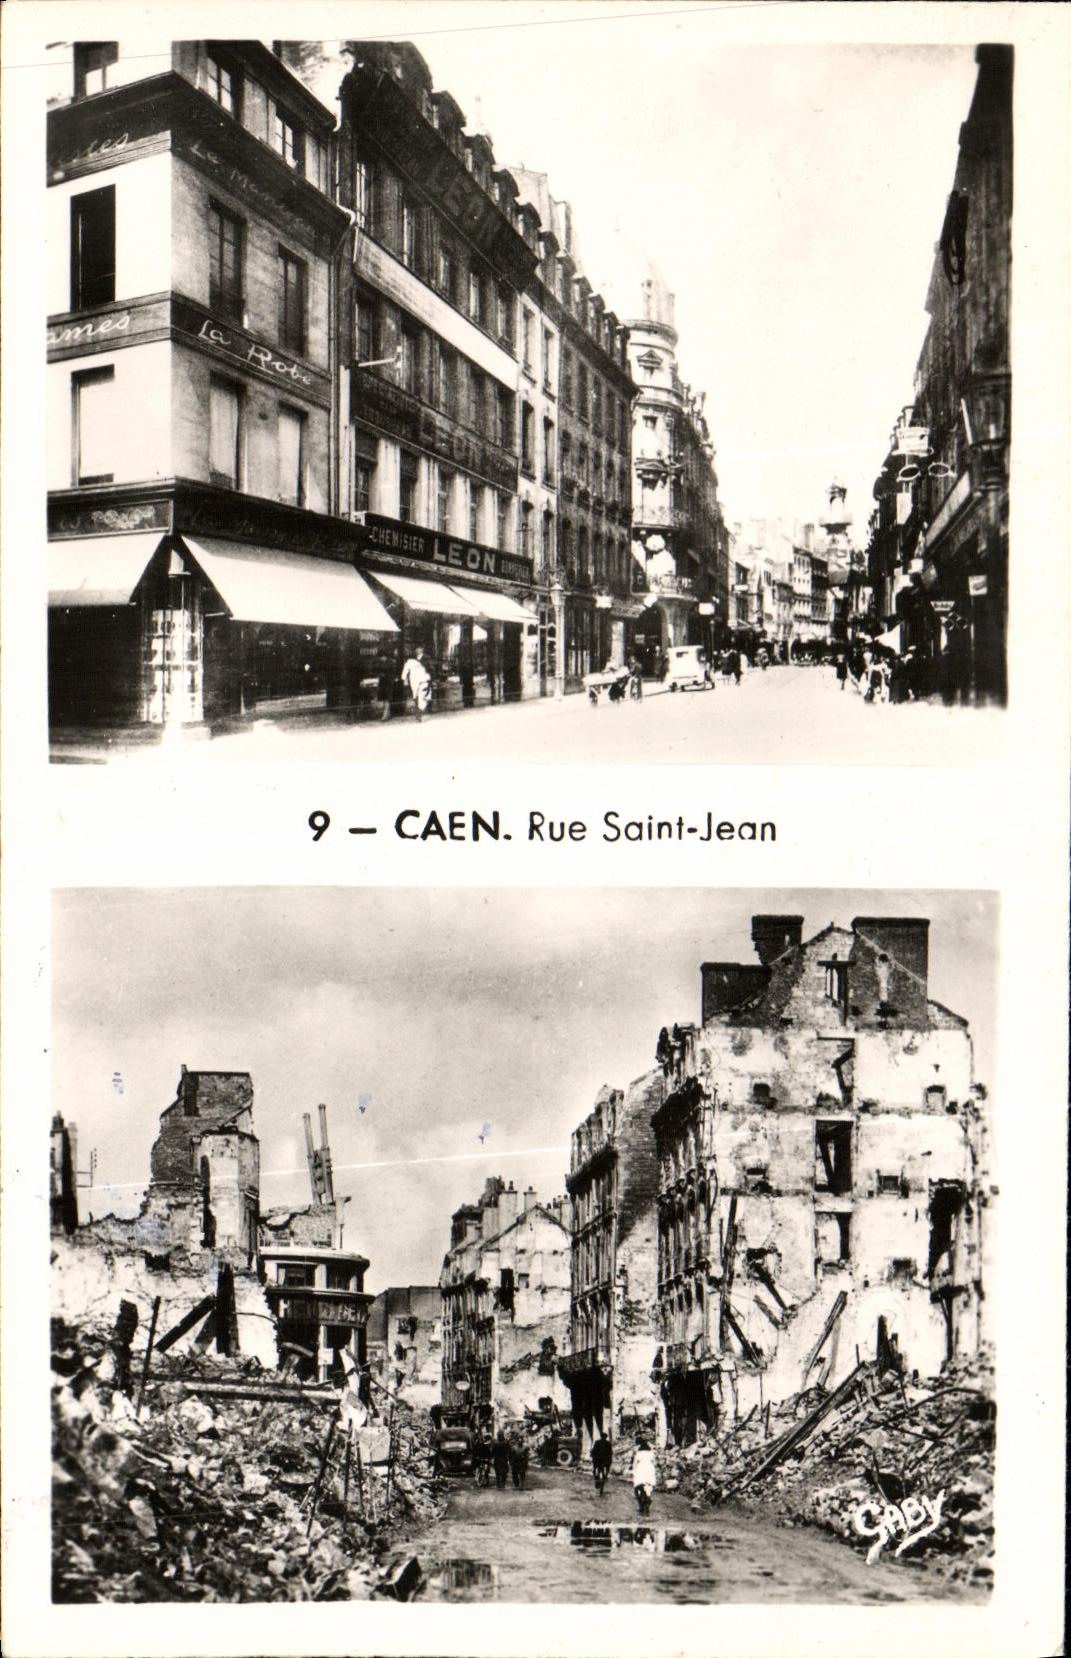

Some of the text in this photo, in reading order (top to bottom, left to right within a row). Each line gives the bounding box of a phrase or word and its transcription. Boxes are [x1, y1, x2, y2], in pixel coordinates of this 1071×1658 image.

[198, 319, 312, 386] La Robe
[371, 526, 425, 553] CHEMISIER
[433, 538, 497, 574] LEON
